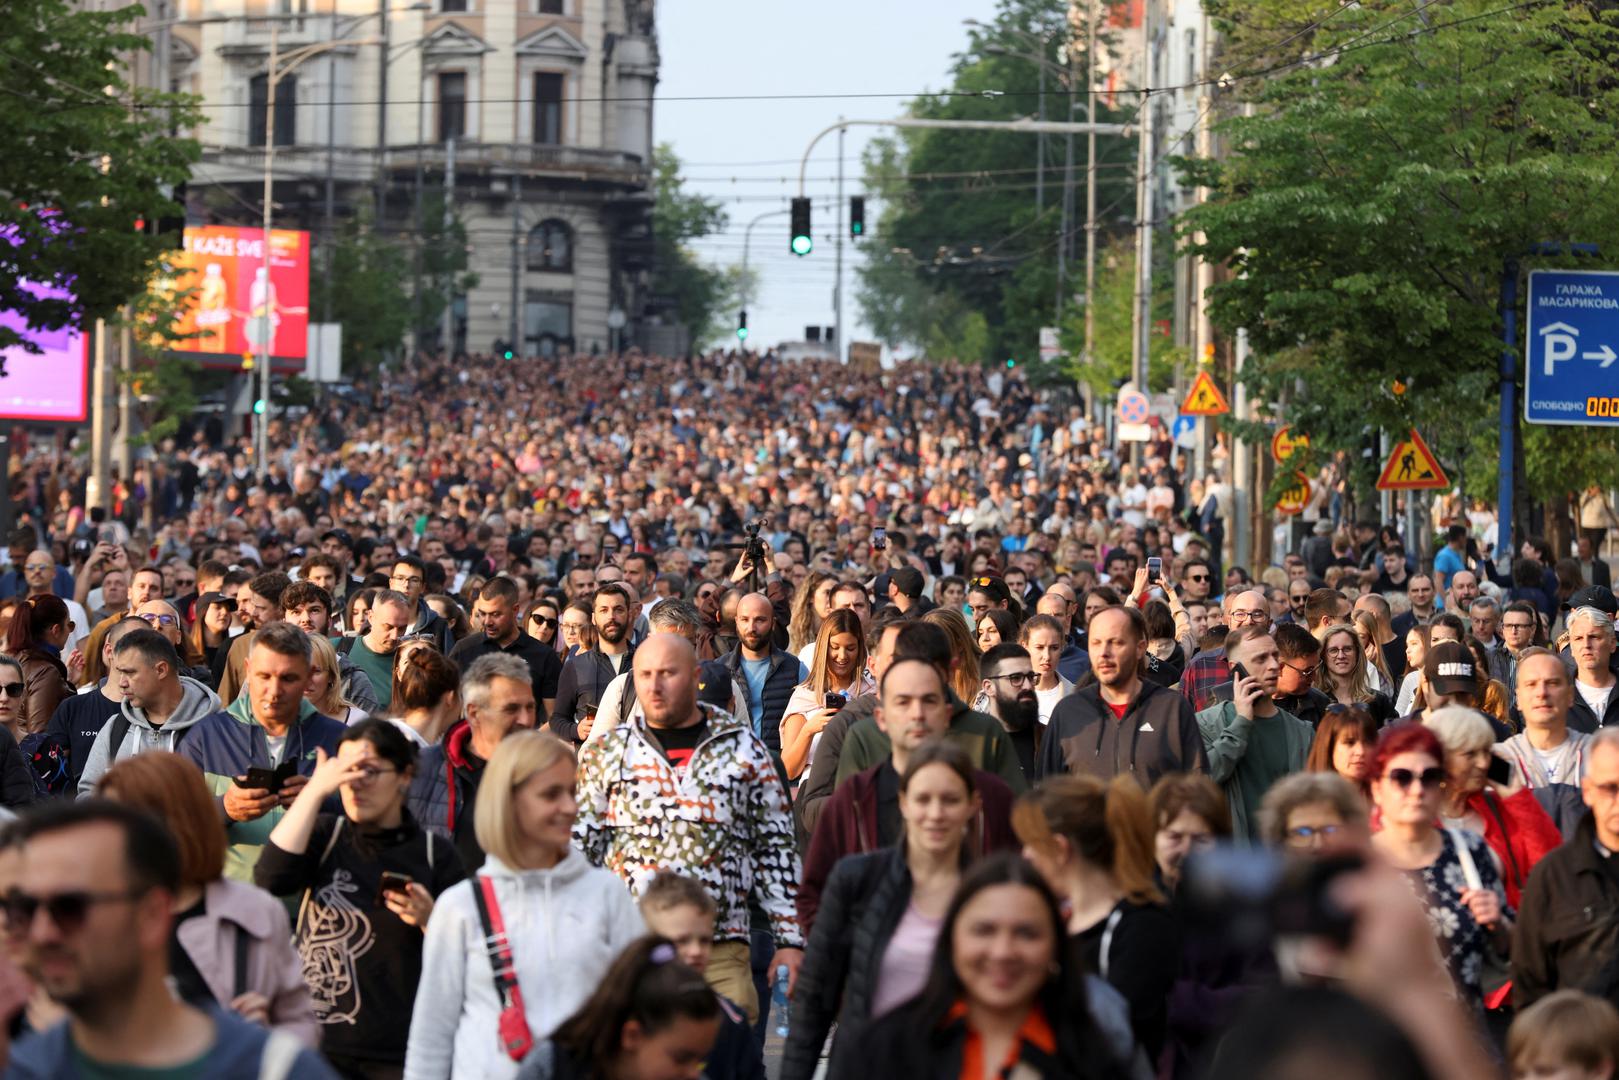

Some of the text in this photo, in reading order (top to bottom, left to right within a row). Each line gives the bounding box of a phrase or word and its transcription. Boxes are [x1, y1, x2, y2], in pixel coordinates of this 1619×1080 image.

[1556, 284, 1602, 296] ГАРАЖА
[1539, 296, 1619, 309] МАСАРИКОВА
[1438, 662, 1472, 676] SAVAGE
